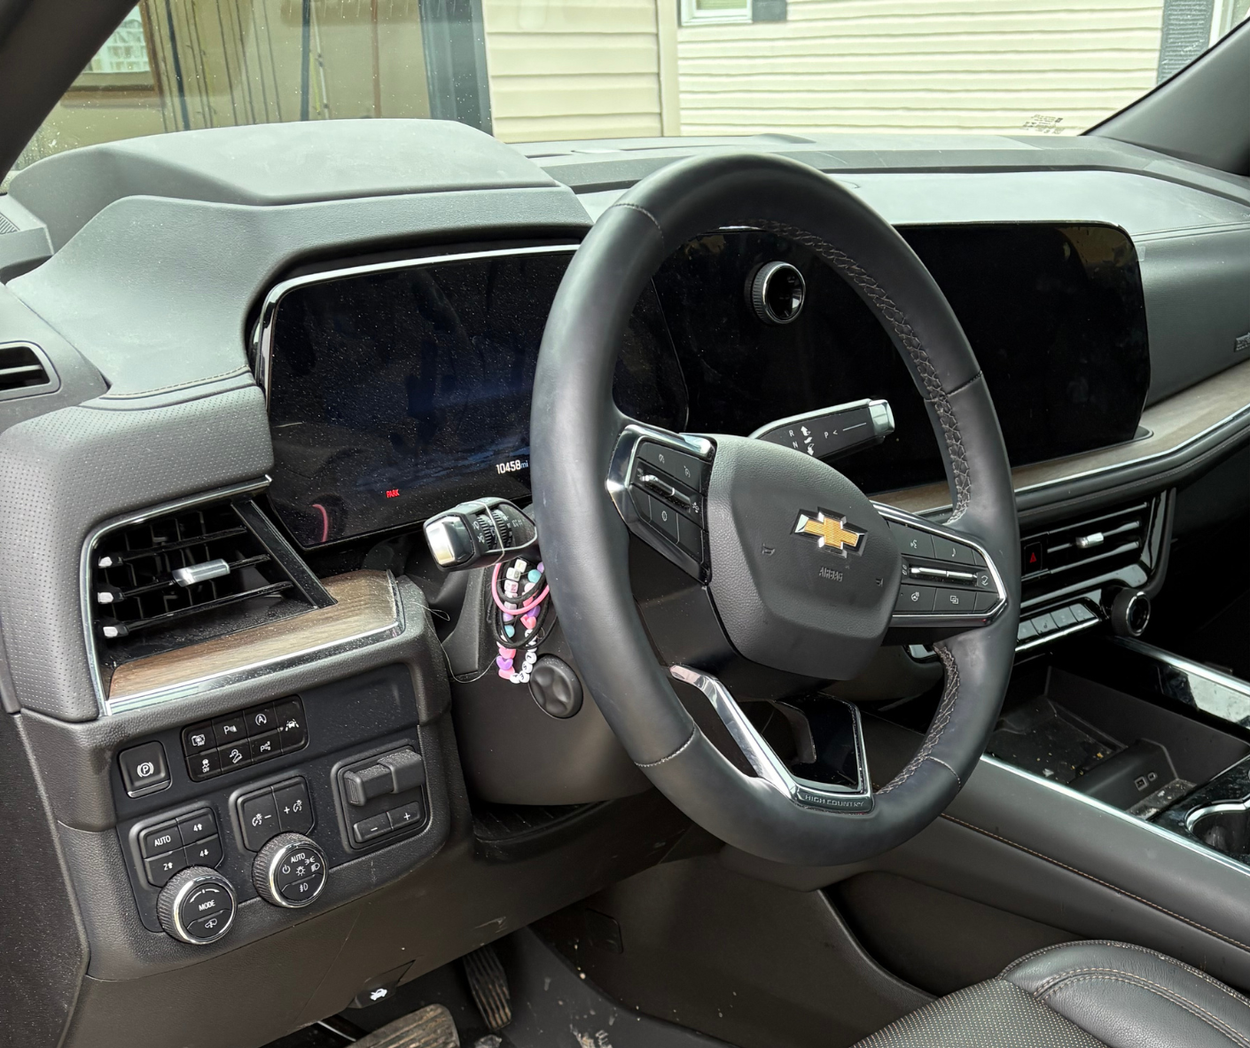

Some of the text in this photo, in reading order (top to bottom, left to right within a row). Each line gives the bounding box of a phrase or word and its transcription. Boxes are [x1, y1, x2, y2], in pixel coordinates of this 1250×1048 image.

[788, 429, 795, 437] R
[824, 431, 829, 439] P
[792, 441, 799, 449] N
[385, 489, 400, 498] PARK
[805, 794, 826, 804] HIGH
[154, 835, 171, 847] AUTO
[290, 853, 306, 864] AUTO
[198, 899, 216, 912] MODE
